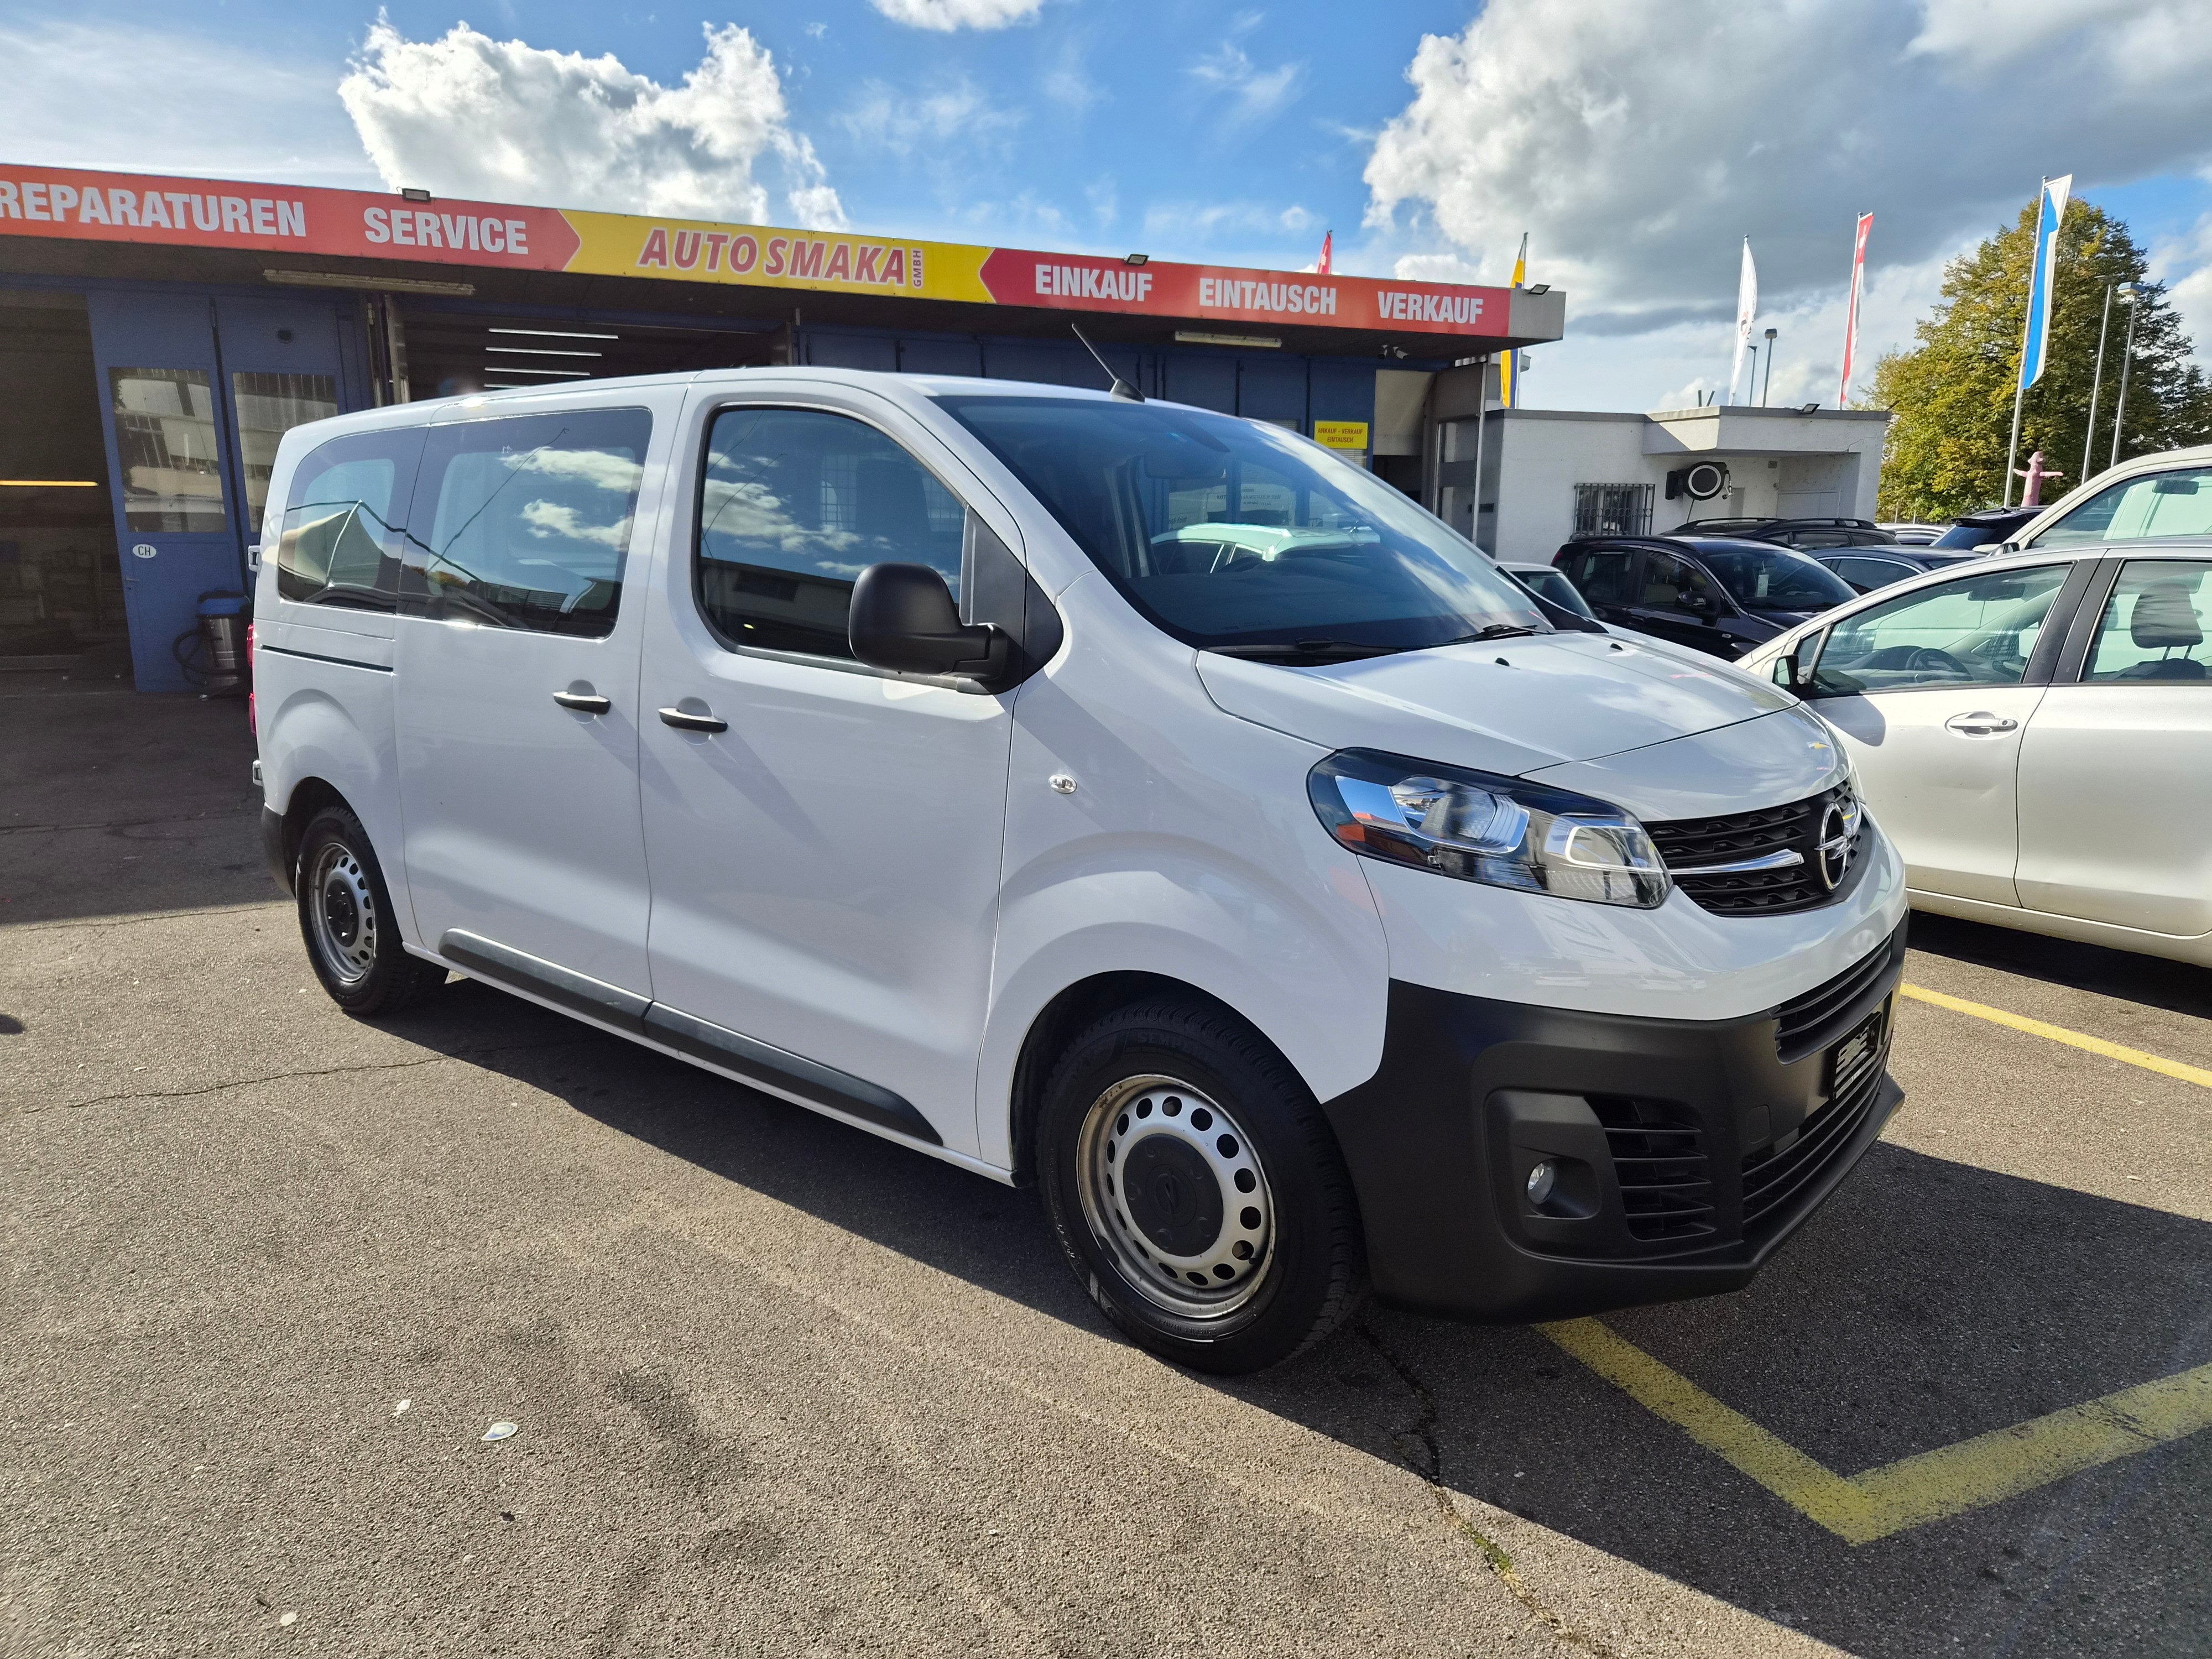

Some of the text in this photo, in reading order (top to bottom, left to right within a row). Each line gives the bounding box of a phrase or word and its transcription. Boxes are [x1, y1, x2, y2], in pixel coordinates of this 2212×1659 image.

[0, 181, 528, 255] REPARATUREN SERVICE
[639, 229, 905, 285] AUTO SMAKA
[912, 249, 922, 288] GMBH
[1036, 264, 1484, 325] EINKAUF EINTAUSCH VERKAUF
[138, 546, 150, 556] CH
